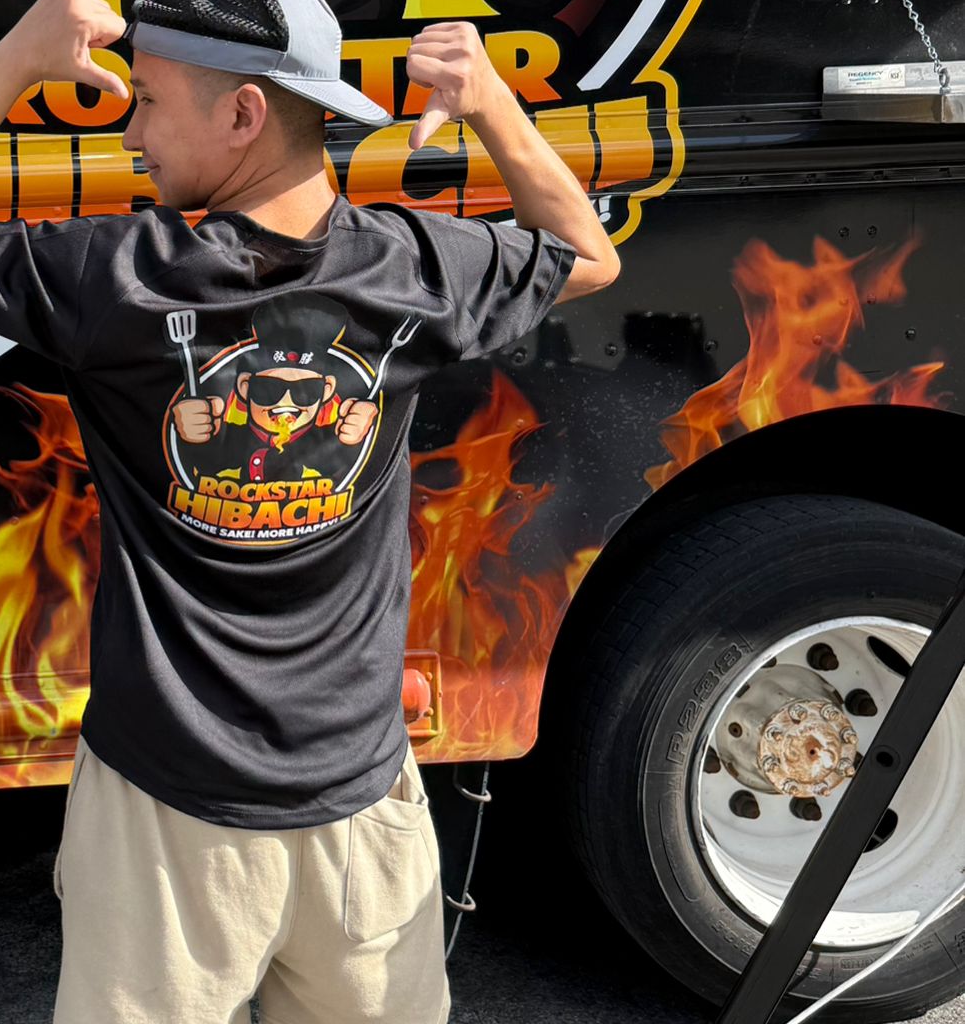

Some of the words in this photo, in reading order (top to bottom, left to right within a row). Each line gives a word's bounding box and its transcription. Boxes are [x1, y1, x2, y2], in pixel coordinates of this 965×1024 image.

[198, 476, 334, 503] ROCKSTAR
[174, 488, 349, 529] HIBACHI
[181, 513, 217, 534] MORE
[219, 528, 255, 539] SAKE!
[257, 528, 294, 539] MORE
